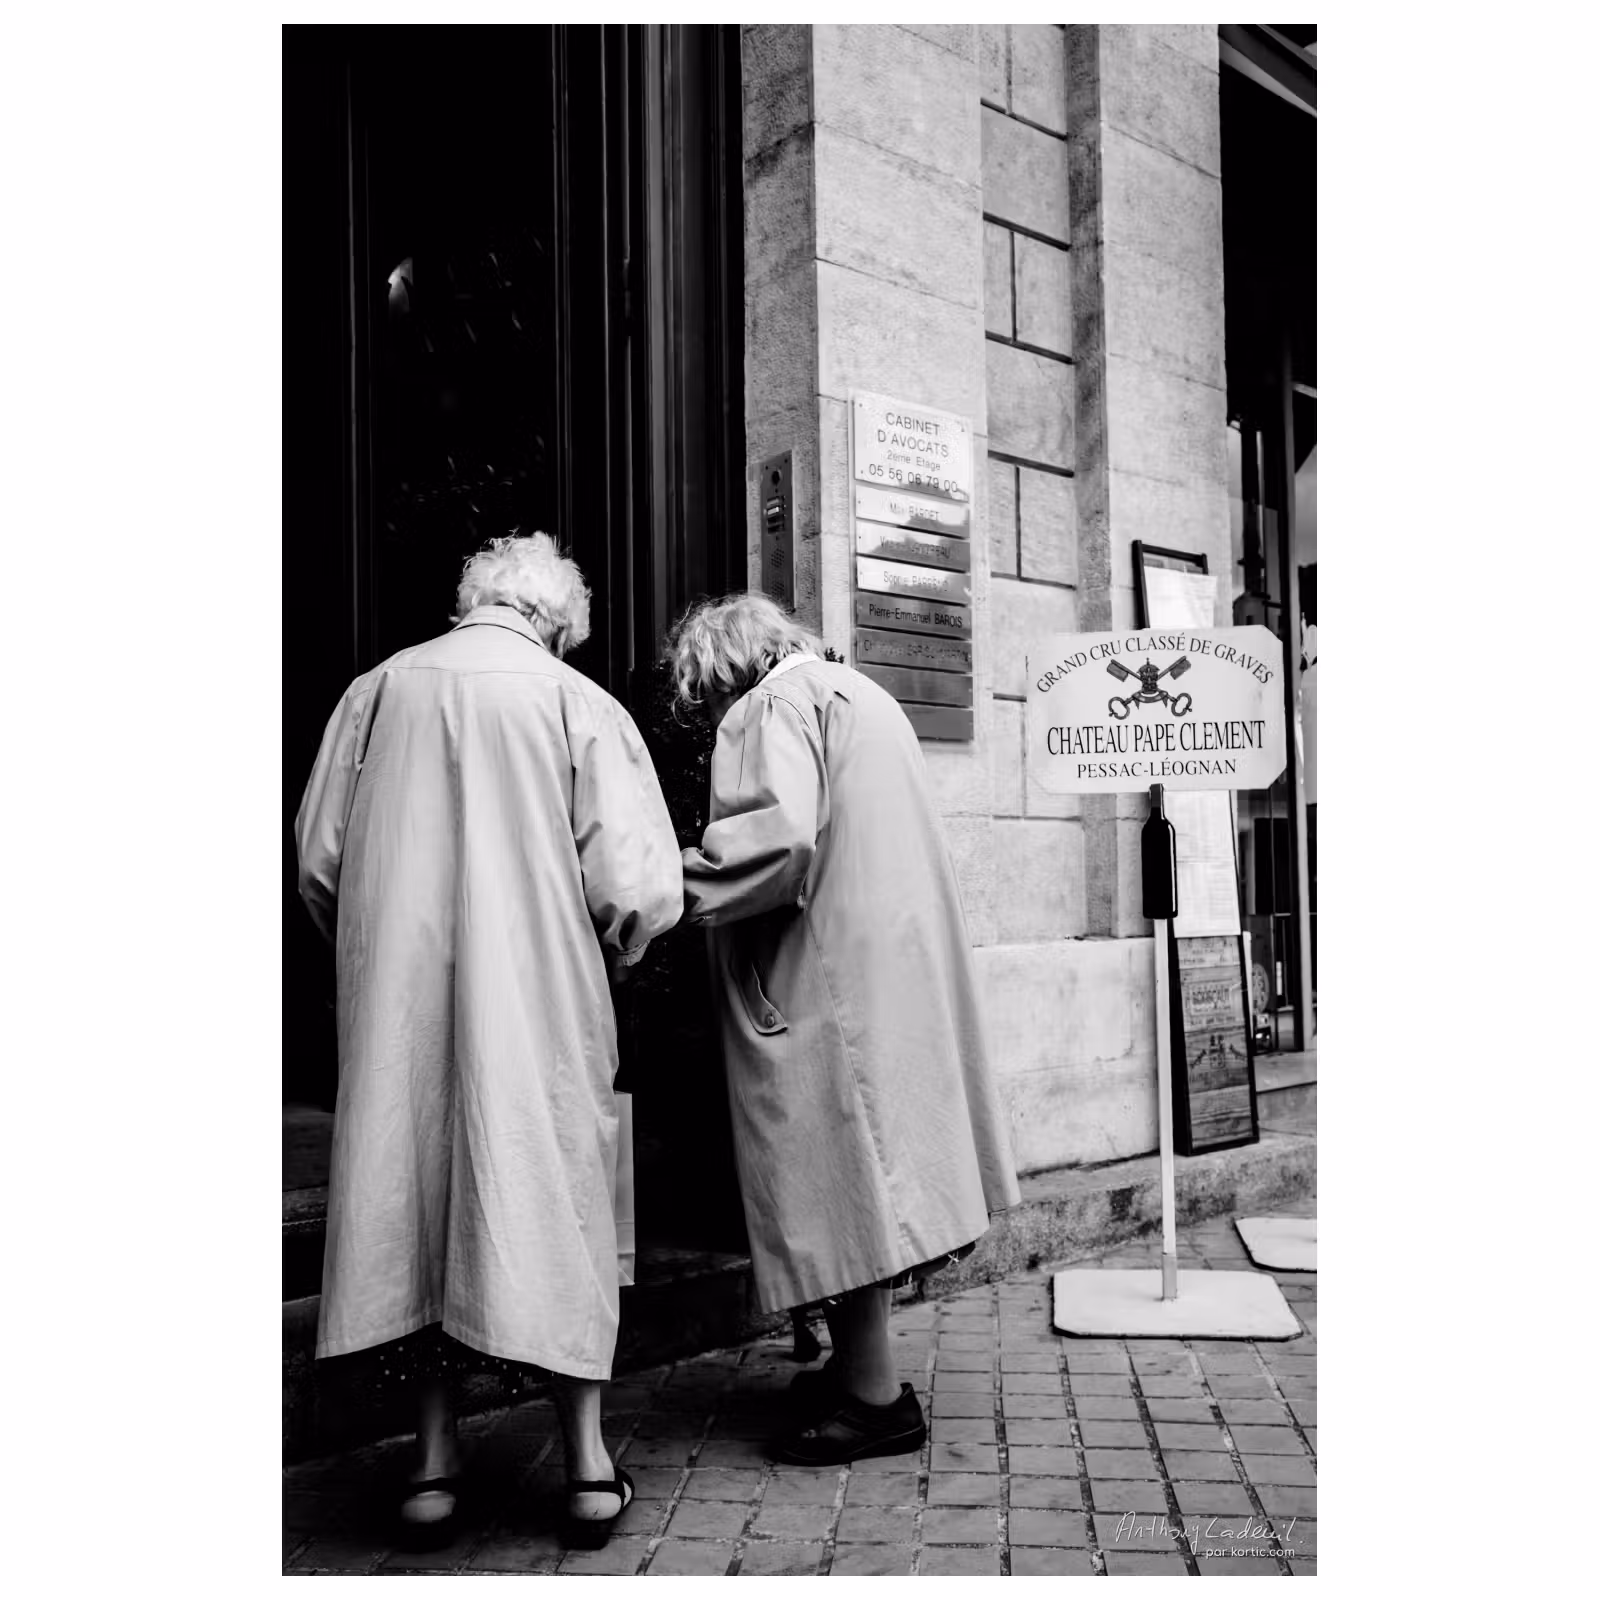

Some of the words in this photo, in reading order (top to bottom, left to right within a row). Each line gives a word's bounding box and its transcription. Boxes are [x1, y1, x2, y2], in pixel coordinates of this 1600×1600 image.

[885, 412, 940, 436] CABINET
[868, 463, 884, 477] 05
[888, 467, 903, 481] 56
[926, 475, 940, 489] 79
[943, 479, 958, 493] 00
[869, 603, 931, 625] Pierre-Emmanuel
[934, 612, 963, 628] BAROIS
[1036, 652, 1087, 692] GRAND
[1089, 640, 1121, 661] CRU
[1125, 632, 1186, 652] CLASSÉ
[1189, 638, 1212, 655] DE
[1214, 643, 1274, 684] GRAVES
[1047, 725, 1129, 755] CHATEAU
[1133, 723, 1176, 752] PAPE
[1180, 720, 1266, 751] CLEMENT
[1077, 757, 1236, 778] PESSAC-LÉOGNAN
